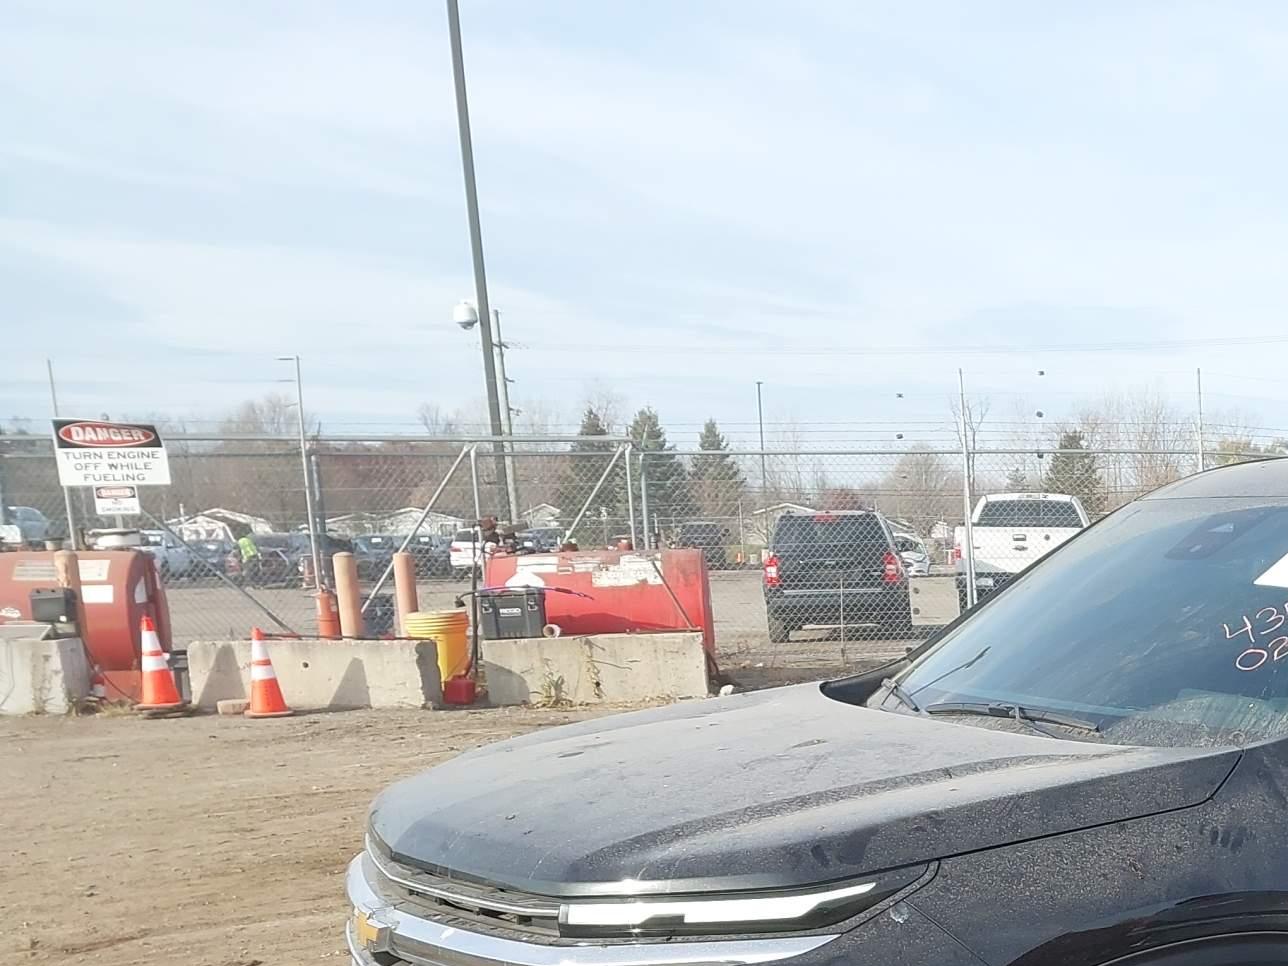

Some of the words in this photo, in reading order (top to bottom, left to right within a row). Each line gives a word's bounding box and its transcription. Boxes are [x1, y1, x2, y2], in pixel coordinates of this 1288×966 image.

[69, 425, 145, 441] DANGER
[63, 451, 103, 460] TURN
[107, 450, 160, 459] ENGINE
[74, 462, 102, 471] OFF
[107, 462, 153, 471] WHILE
[83, 473, 146, 482] FUELING
